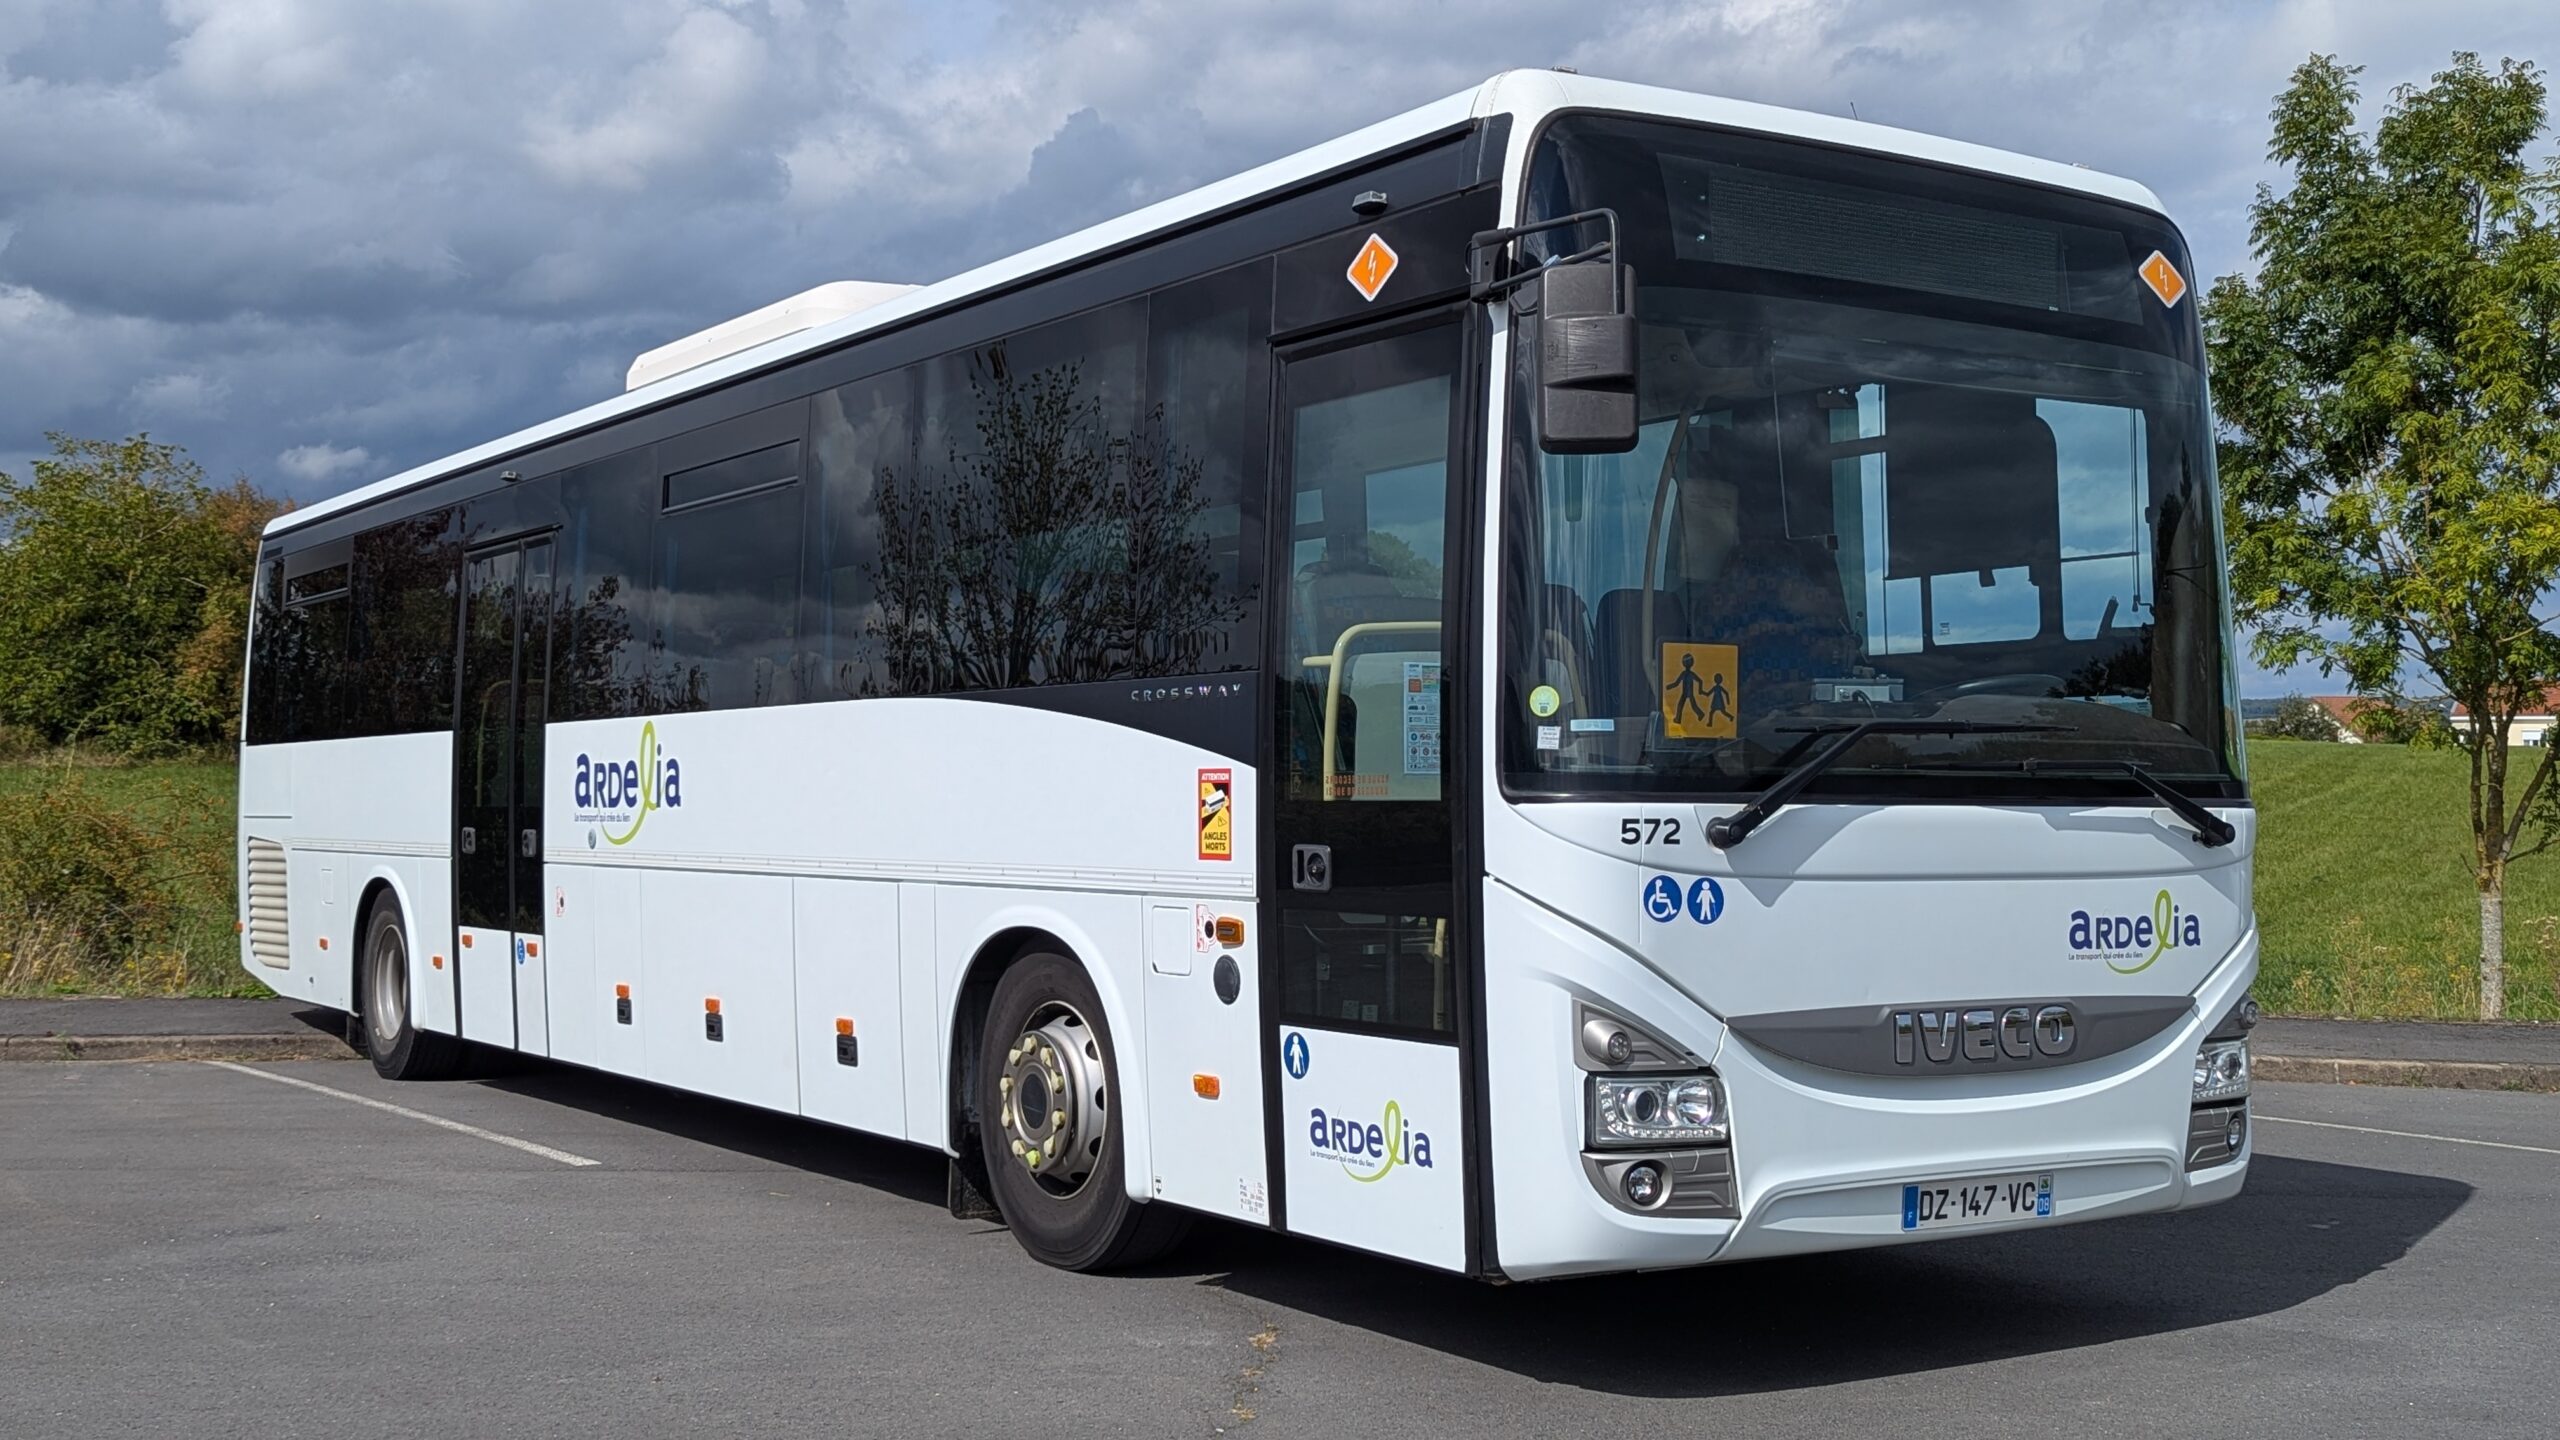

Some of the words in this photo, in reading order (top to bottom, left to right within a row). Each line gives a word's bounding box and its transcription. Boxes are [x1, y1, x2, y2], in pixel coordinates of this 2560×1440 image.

[1131, 684, 1240, 701] CROSSWAY
[1204, 832, 1227, 840] ANGLES
[1621, 818, 1680, 845] 572
[1205, 842, 1226, 851] MORTS
[1894, 1006, 2077, 1064] IVECO
[1919, 1182, 2035, 1221] DZ-147-VC
[2038, 1197, 2049, 1212] 08
[1907, 1211, 1913, 1221] F
